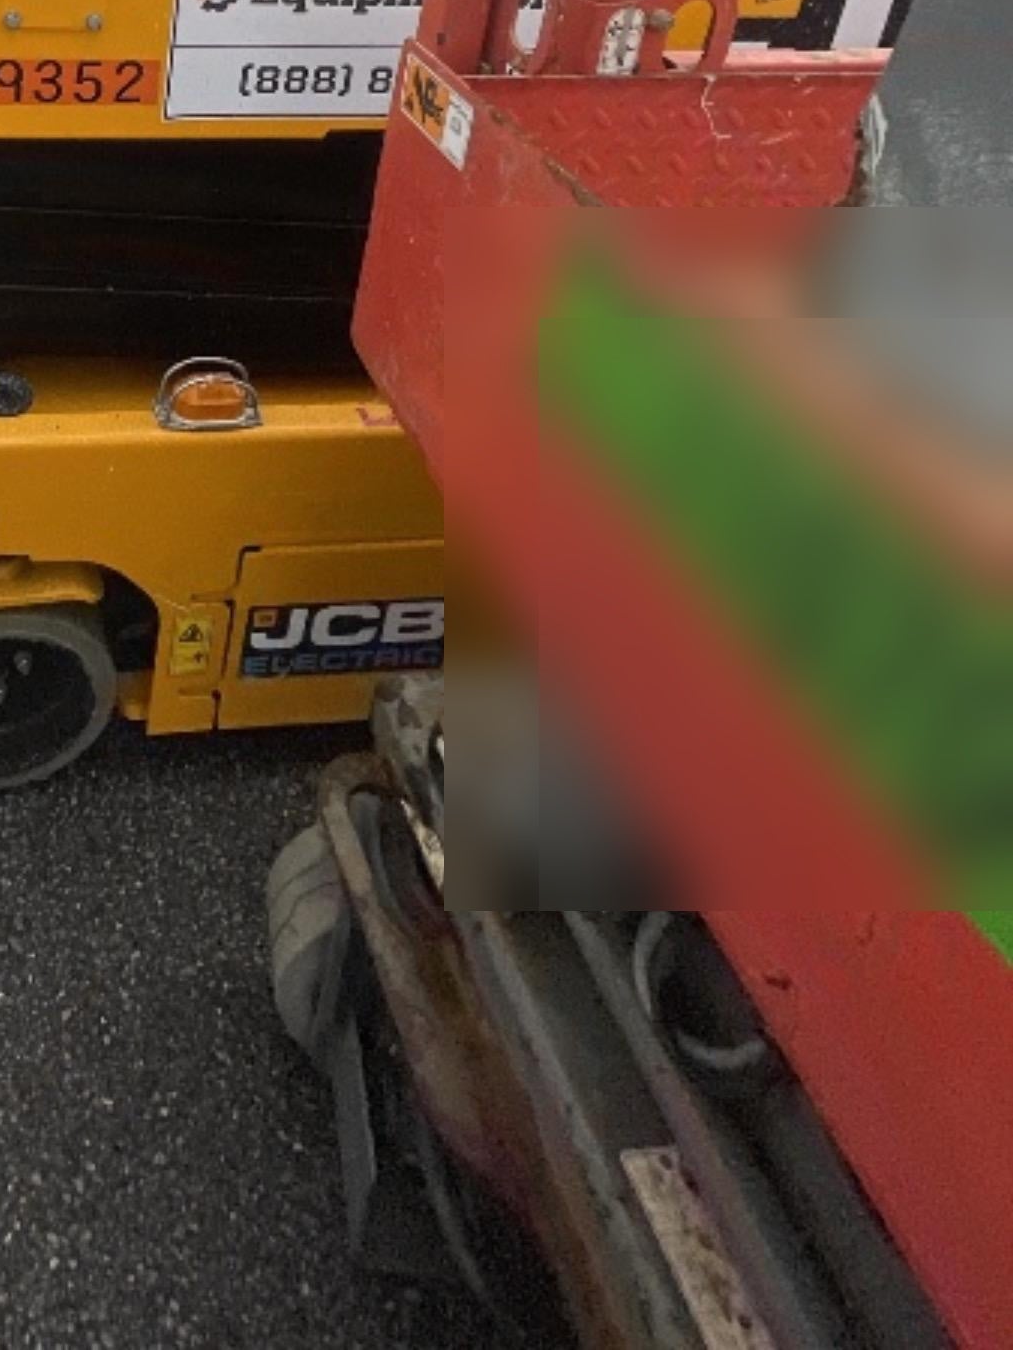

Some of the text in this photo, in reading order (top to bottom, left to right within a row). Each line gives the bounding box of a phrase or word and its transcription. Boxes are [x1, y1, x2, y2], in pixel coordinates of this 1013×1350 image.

[238, 63, 354, 97] (888)
[249, 602, 444, 651] JCB
[244, 649, 438, 675] ELECTRIC
